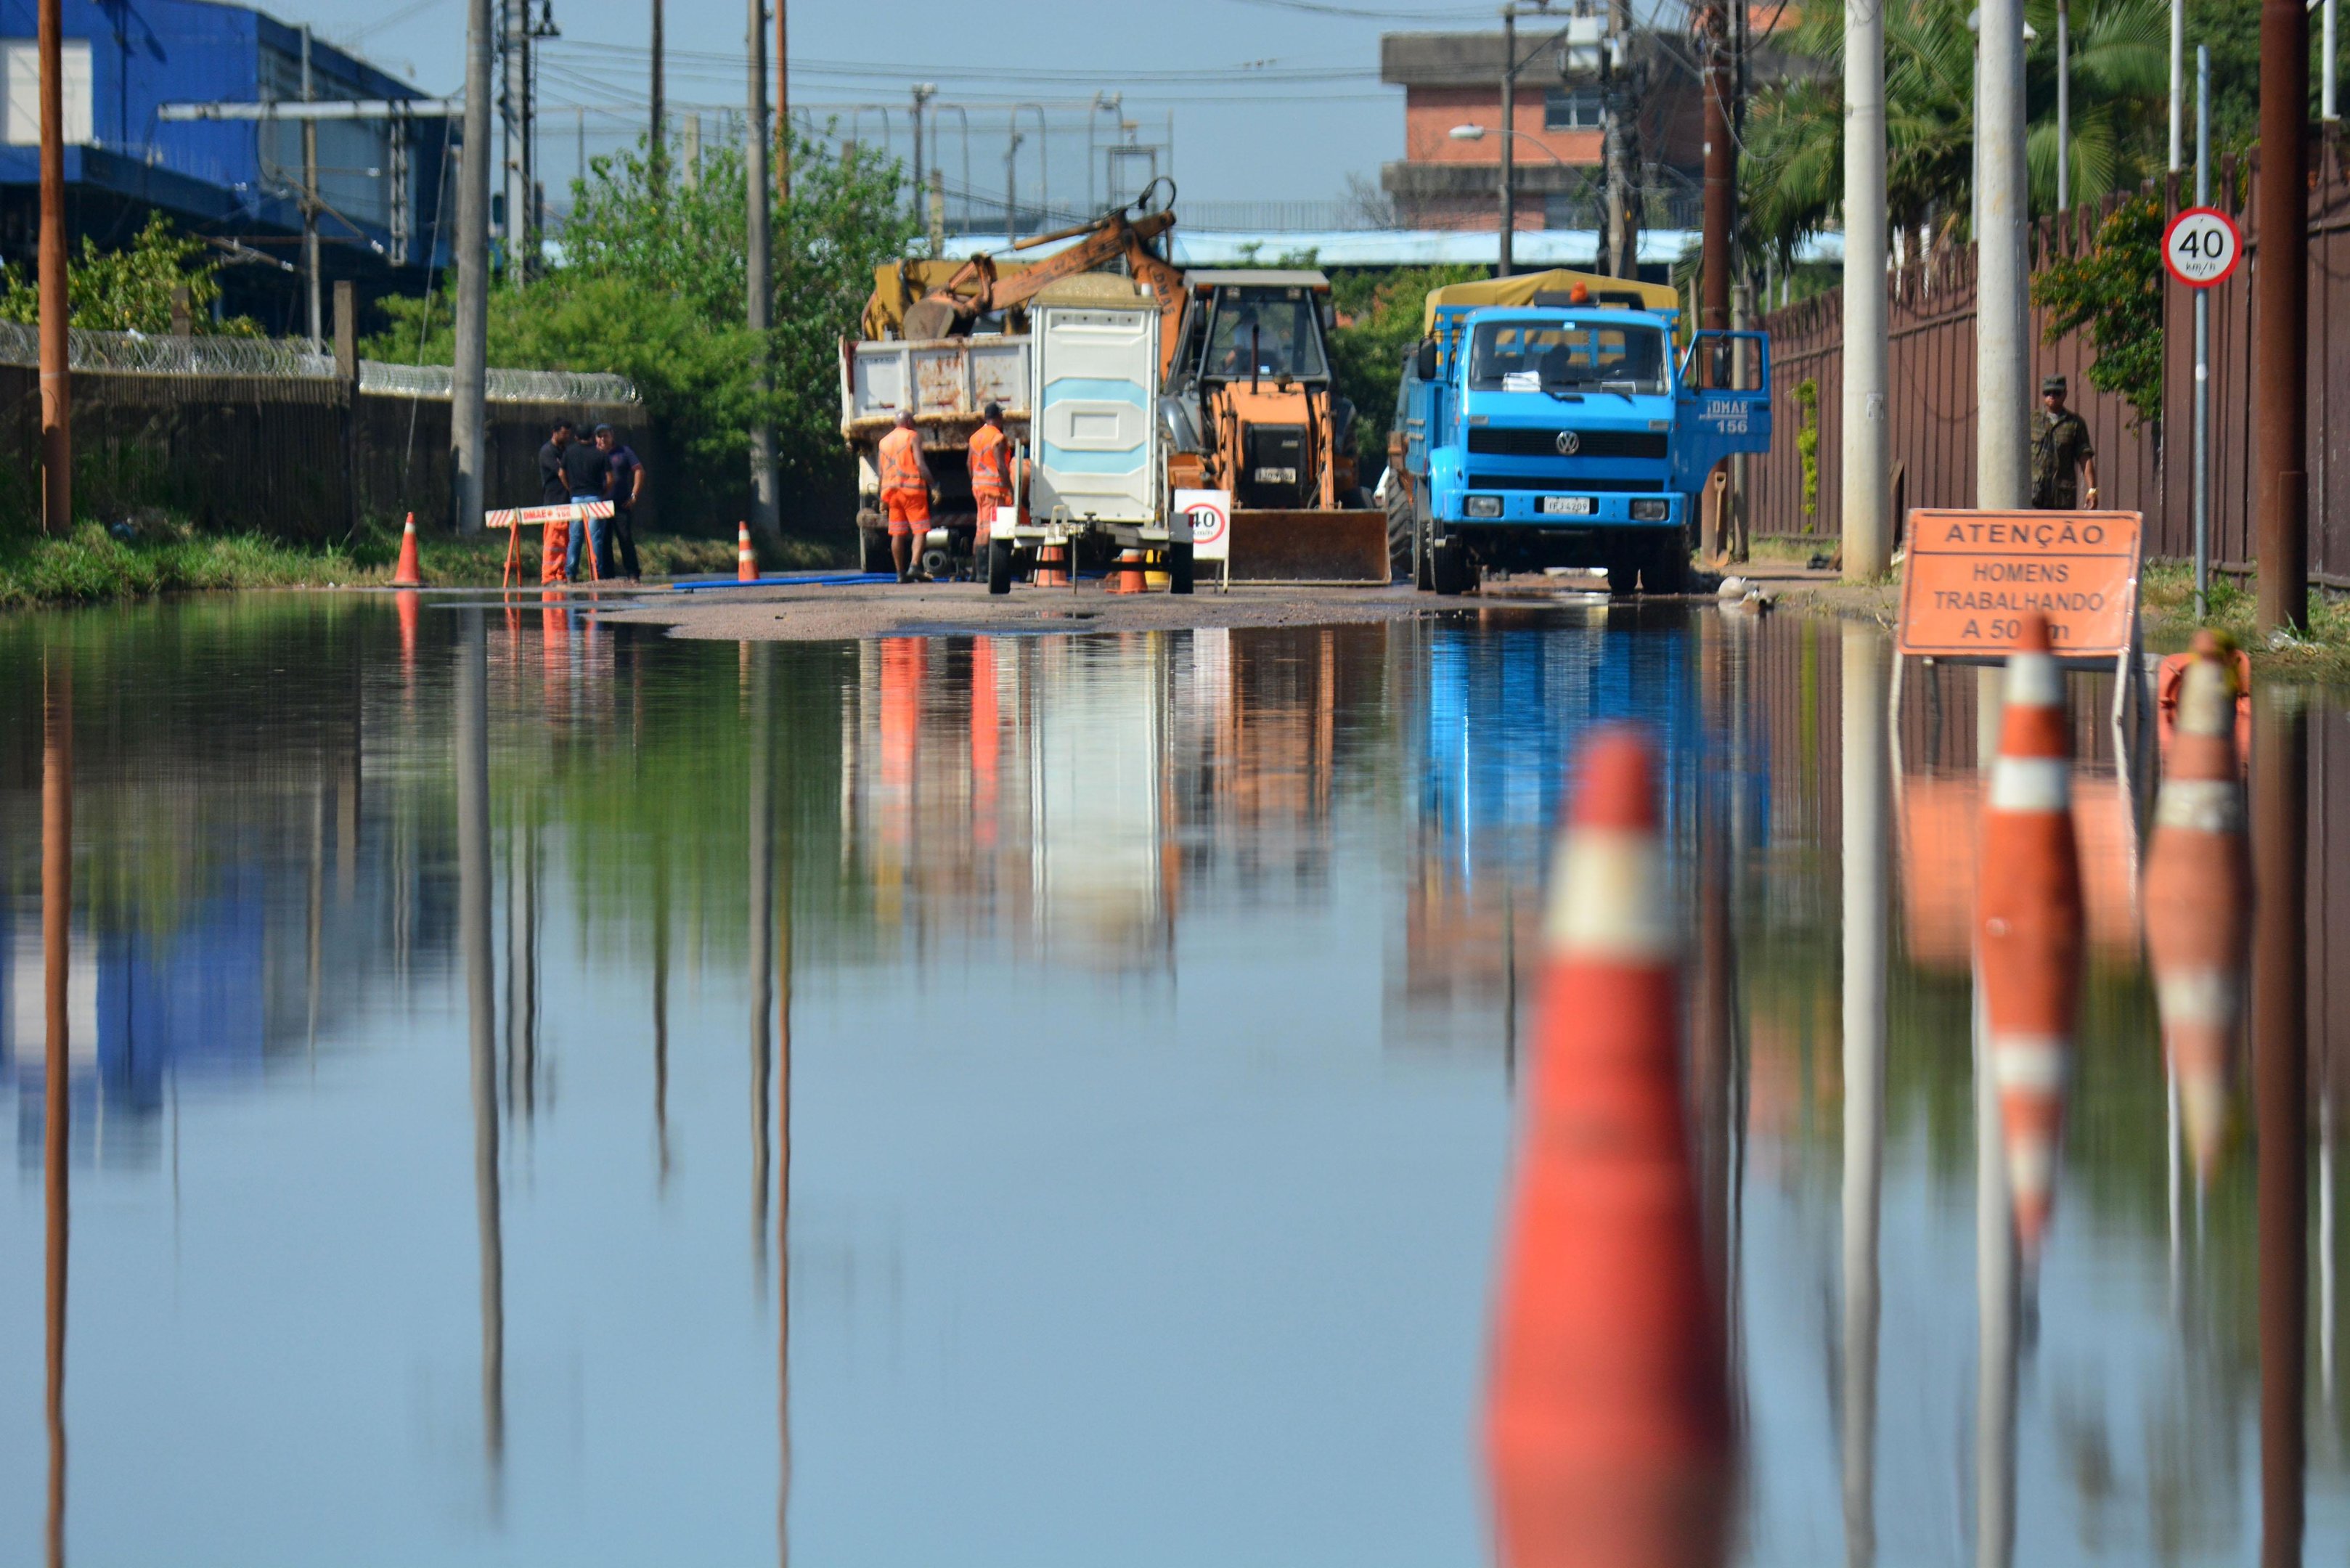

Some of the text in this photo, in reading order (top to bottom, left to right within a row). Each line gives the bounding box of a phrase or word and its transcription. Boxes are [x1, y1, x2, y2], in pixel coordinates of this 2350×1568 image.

[2179, 229, 2224, 258] 40
[1717, 420, 1748, 434] 156
[1945, 520, 2104, 549] ATENÇÃO
[1973, 563, 2069, 582] HOMENS
[1934, 591, 2104, 611] TRABALHANDO
[1962, 619, 1981, 639] A
